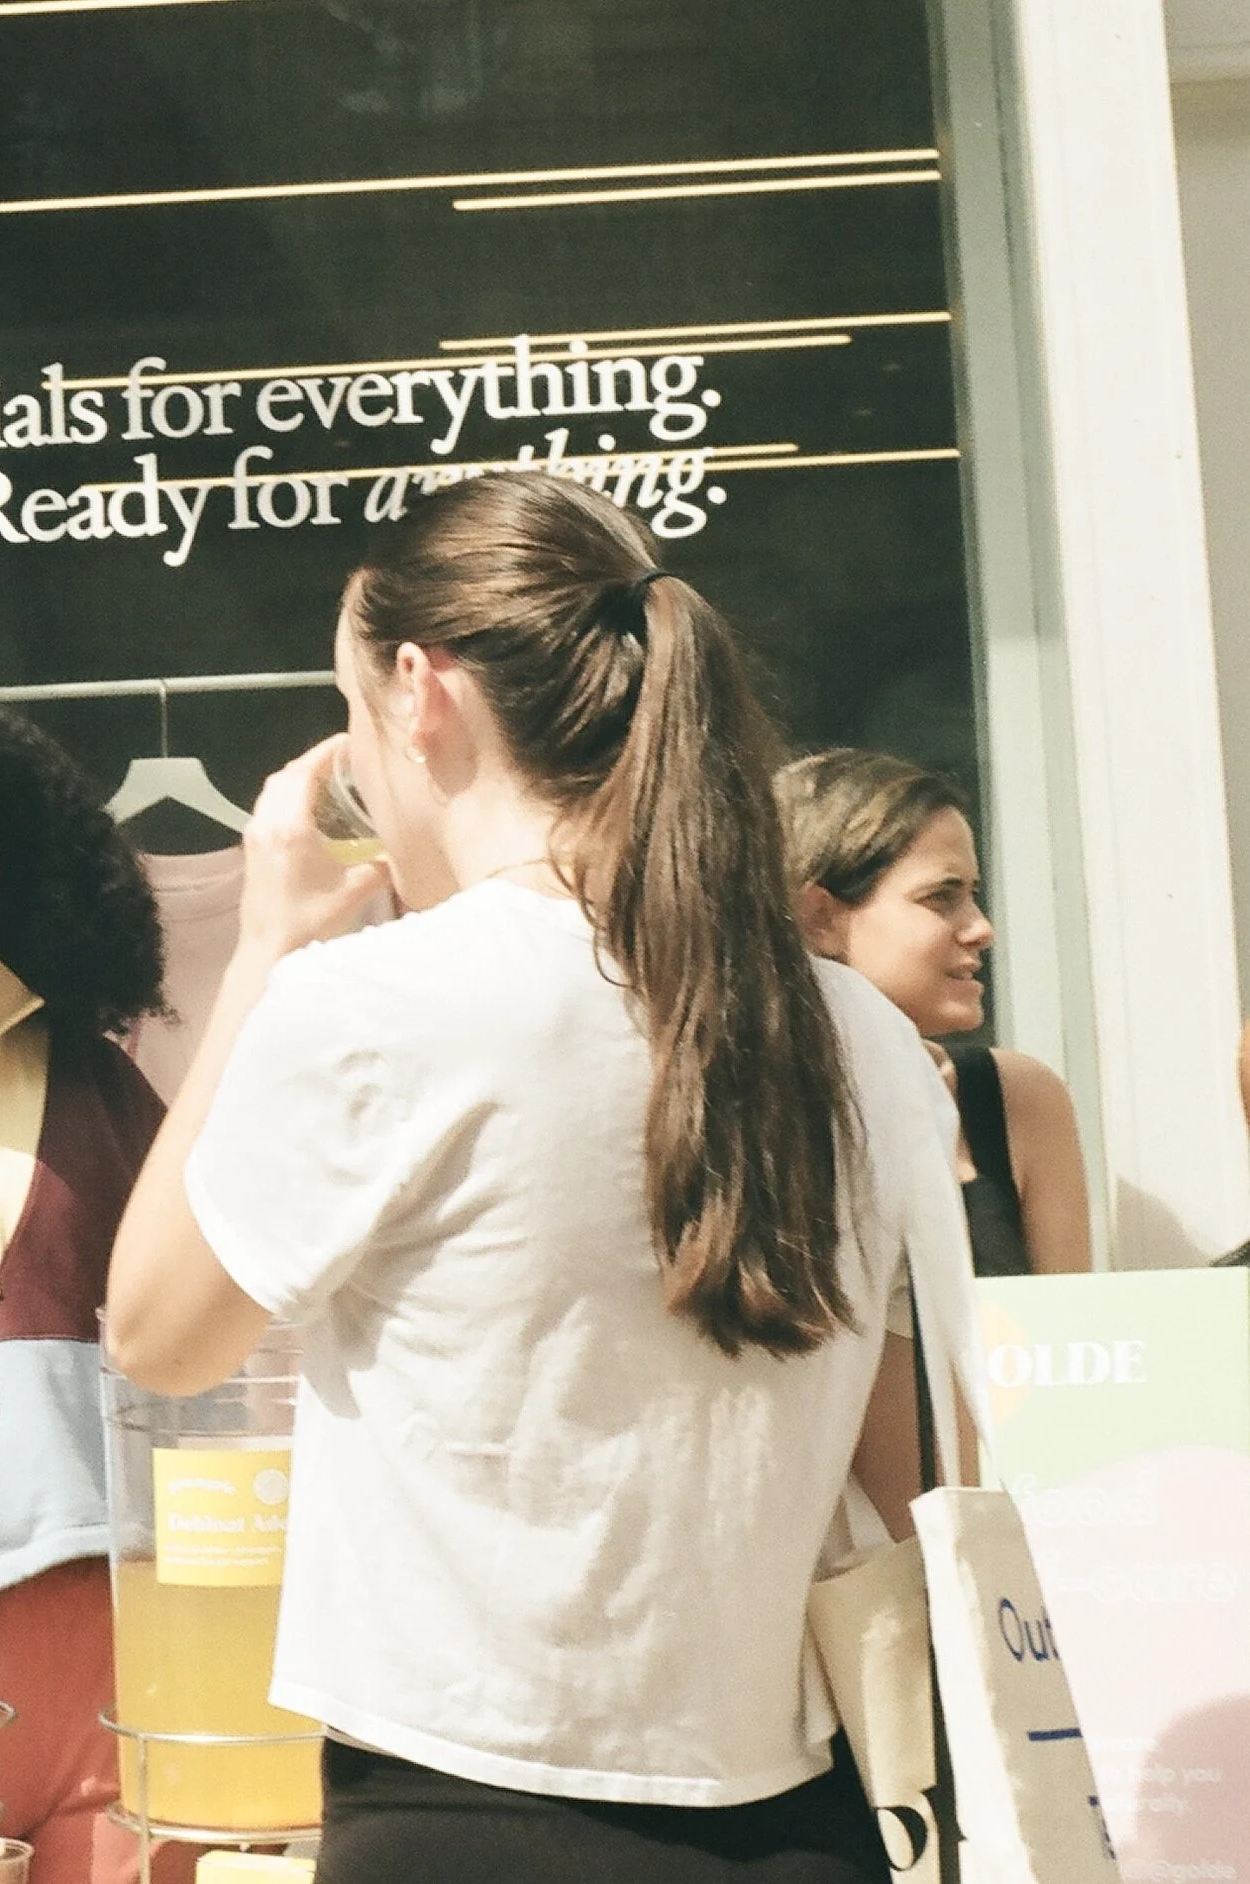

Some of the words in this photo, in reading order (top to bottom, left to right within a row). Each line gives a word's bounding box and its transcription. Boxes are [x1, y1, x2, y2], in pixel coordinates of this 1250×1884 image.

[120, 356, 241, 443] for
[256, 334, 723, 453] everything.
[229, 446, 350, 528] for
[987, 1340, 1148, 1388] OLDE
